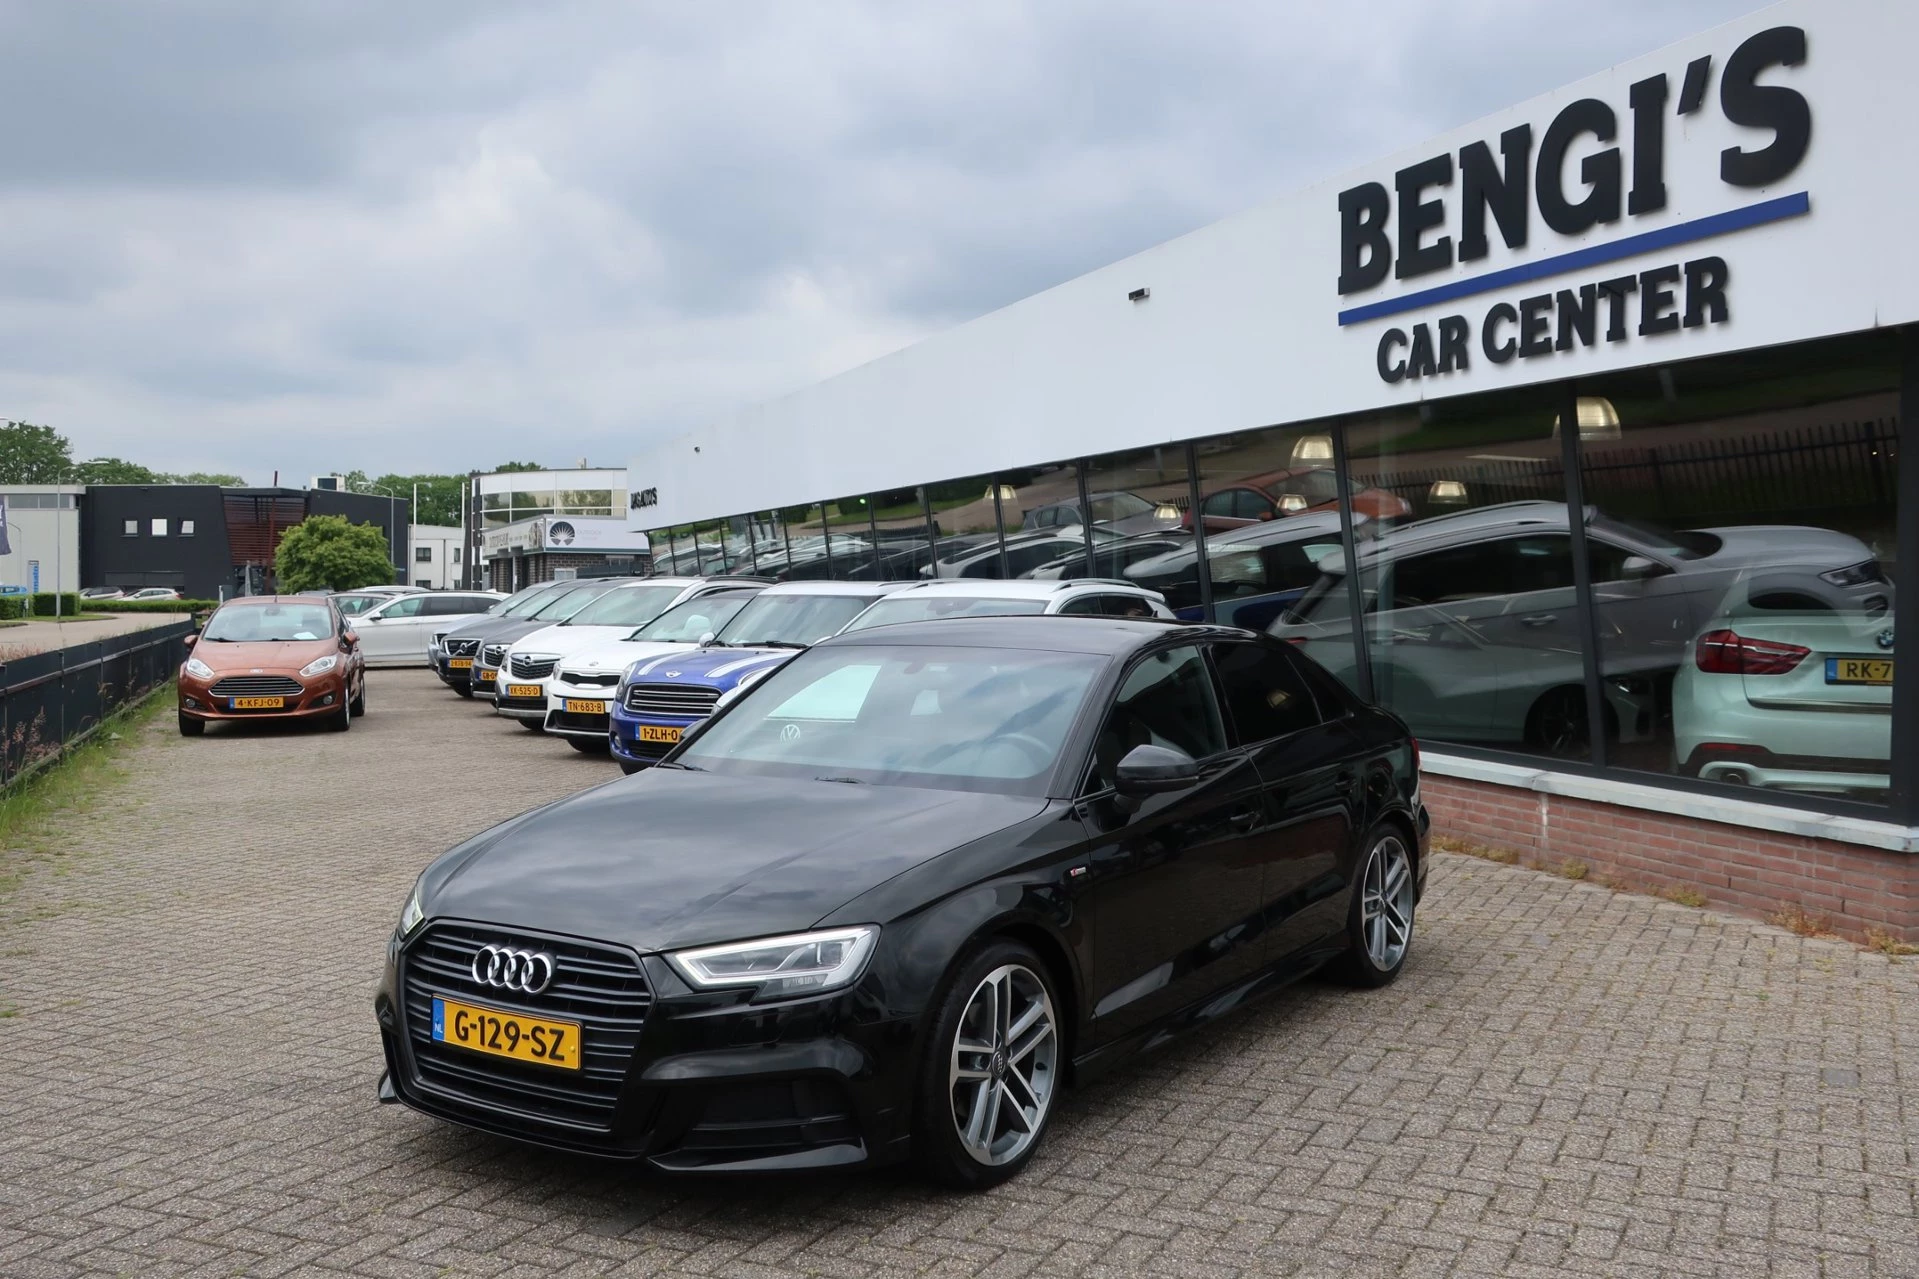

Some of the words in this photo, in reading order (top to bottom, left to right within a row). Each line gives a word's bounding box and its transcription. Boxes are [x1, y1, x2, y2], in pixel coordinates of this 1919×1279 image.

[1338, 26, 1811, 294] BENGI'S
[1377, 314, 1469, 383] CAR
[1482, 256, 1730, 364] CENTER
[1846, 662, 1892, 678] RK-7
[567, 701, 602, 712] TN-683-B
[643, 727, 681, 741] 1-ZLH-0
[434, 1023, 443, 1034] NL
[454, 1009, 566, 1062] G-129-SZ
